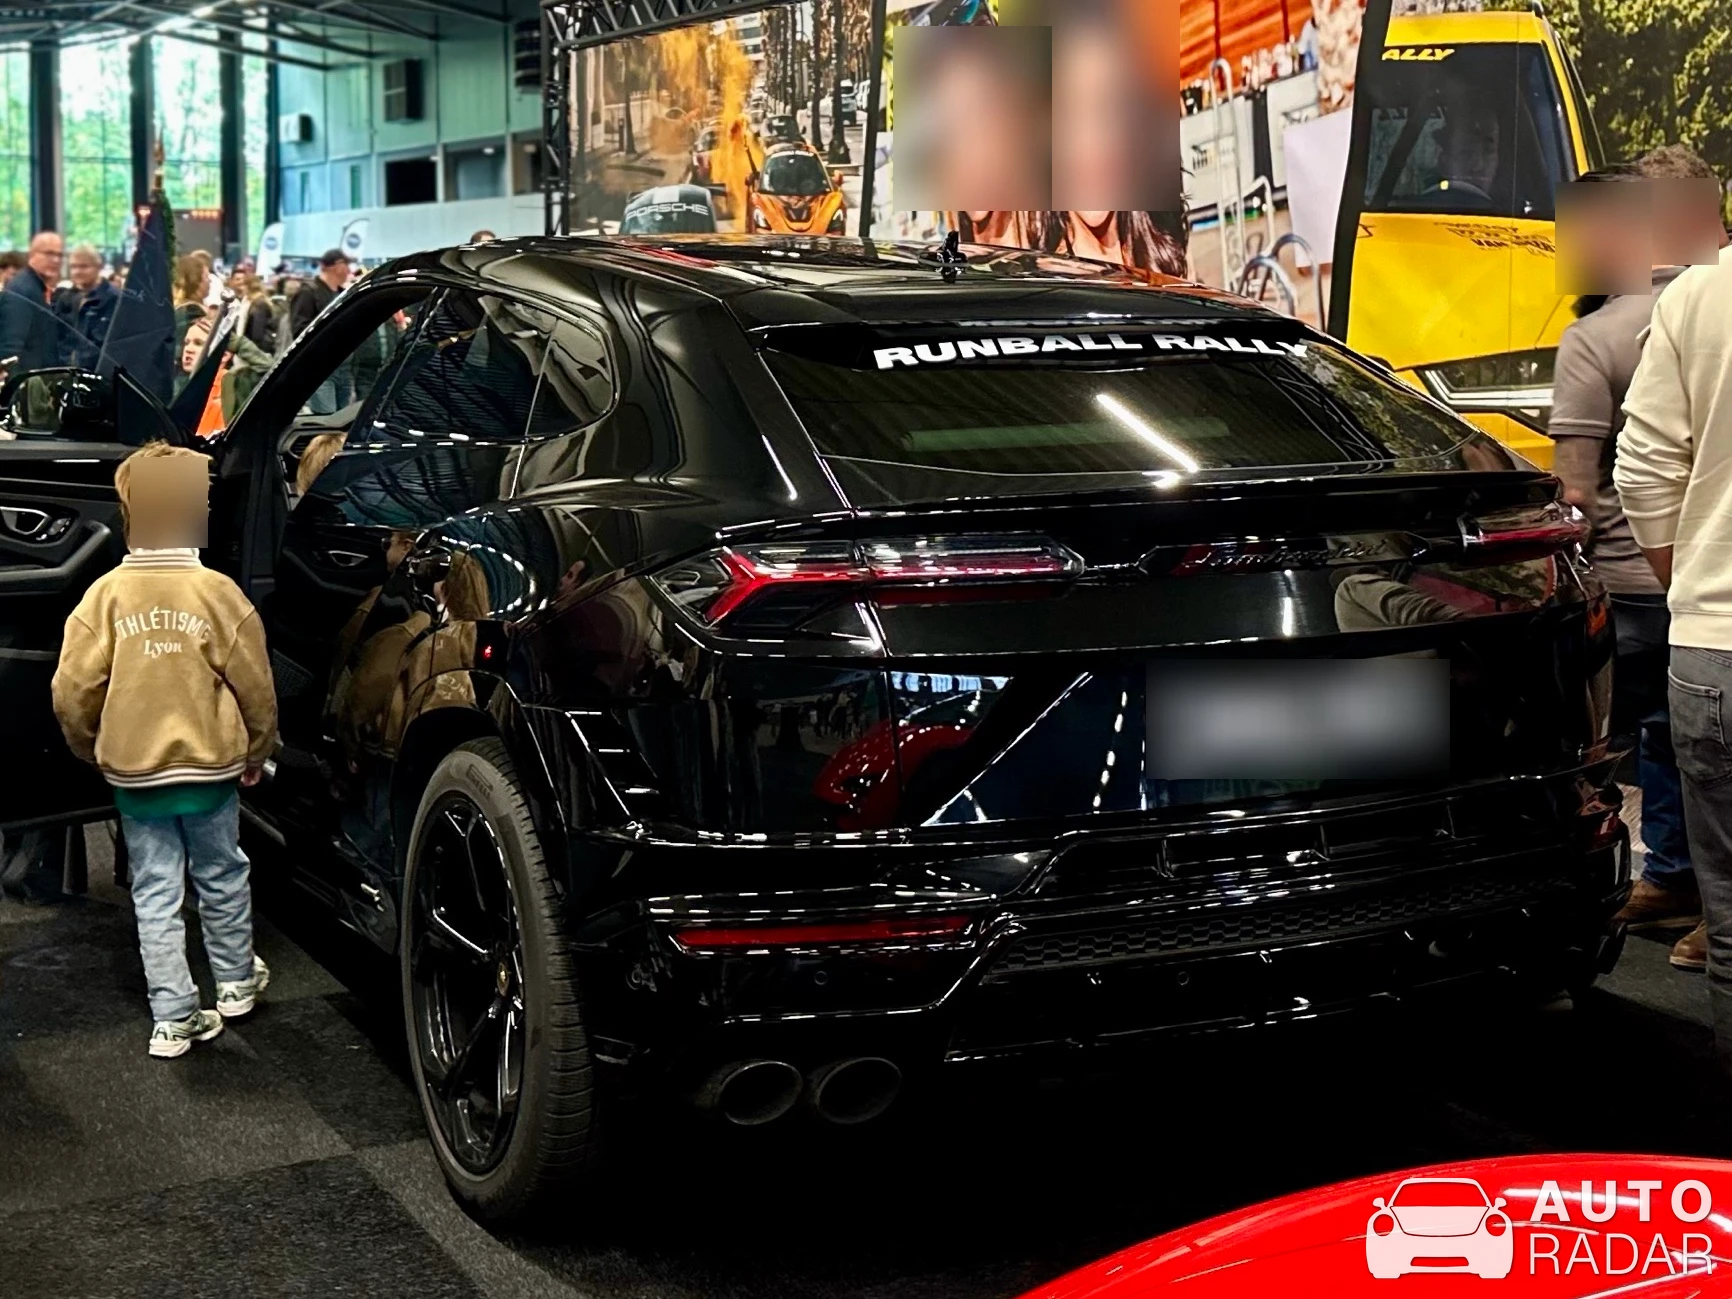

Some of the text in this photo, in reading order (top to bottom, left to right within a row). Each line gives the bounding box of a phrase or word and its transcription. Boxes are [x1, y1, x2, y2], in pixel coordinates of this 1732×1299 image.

[625, 202, 709, 222] PORSCHE
[873, 333, 1308, 369] RUNBALL RALLY
[143, 639, 183, 659] Lyon
